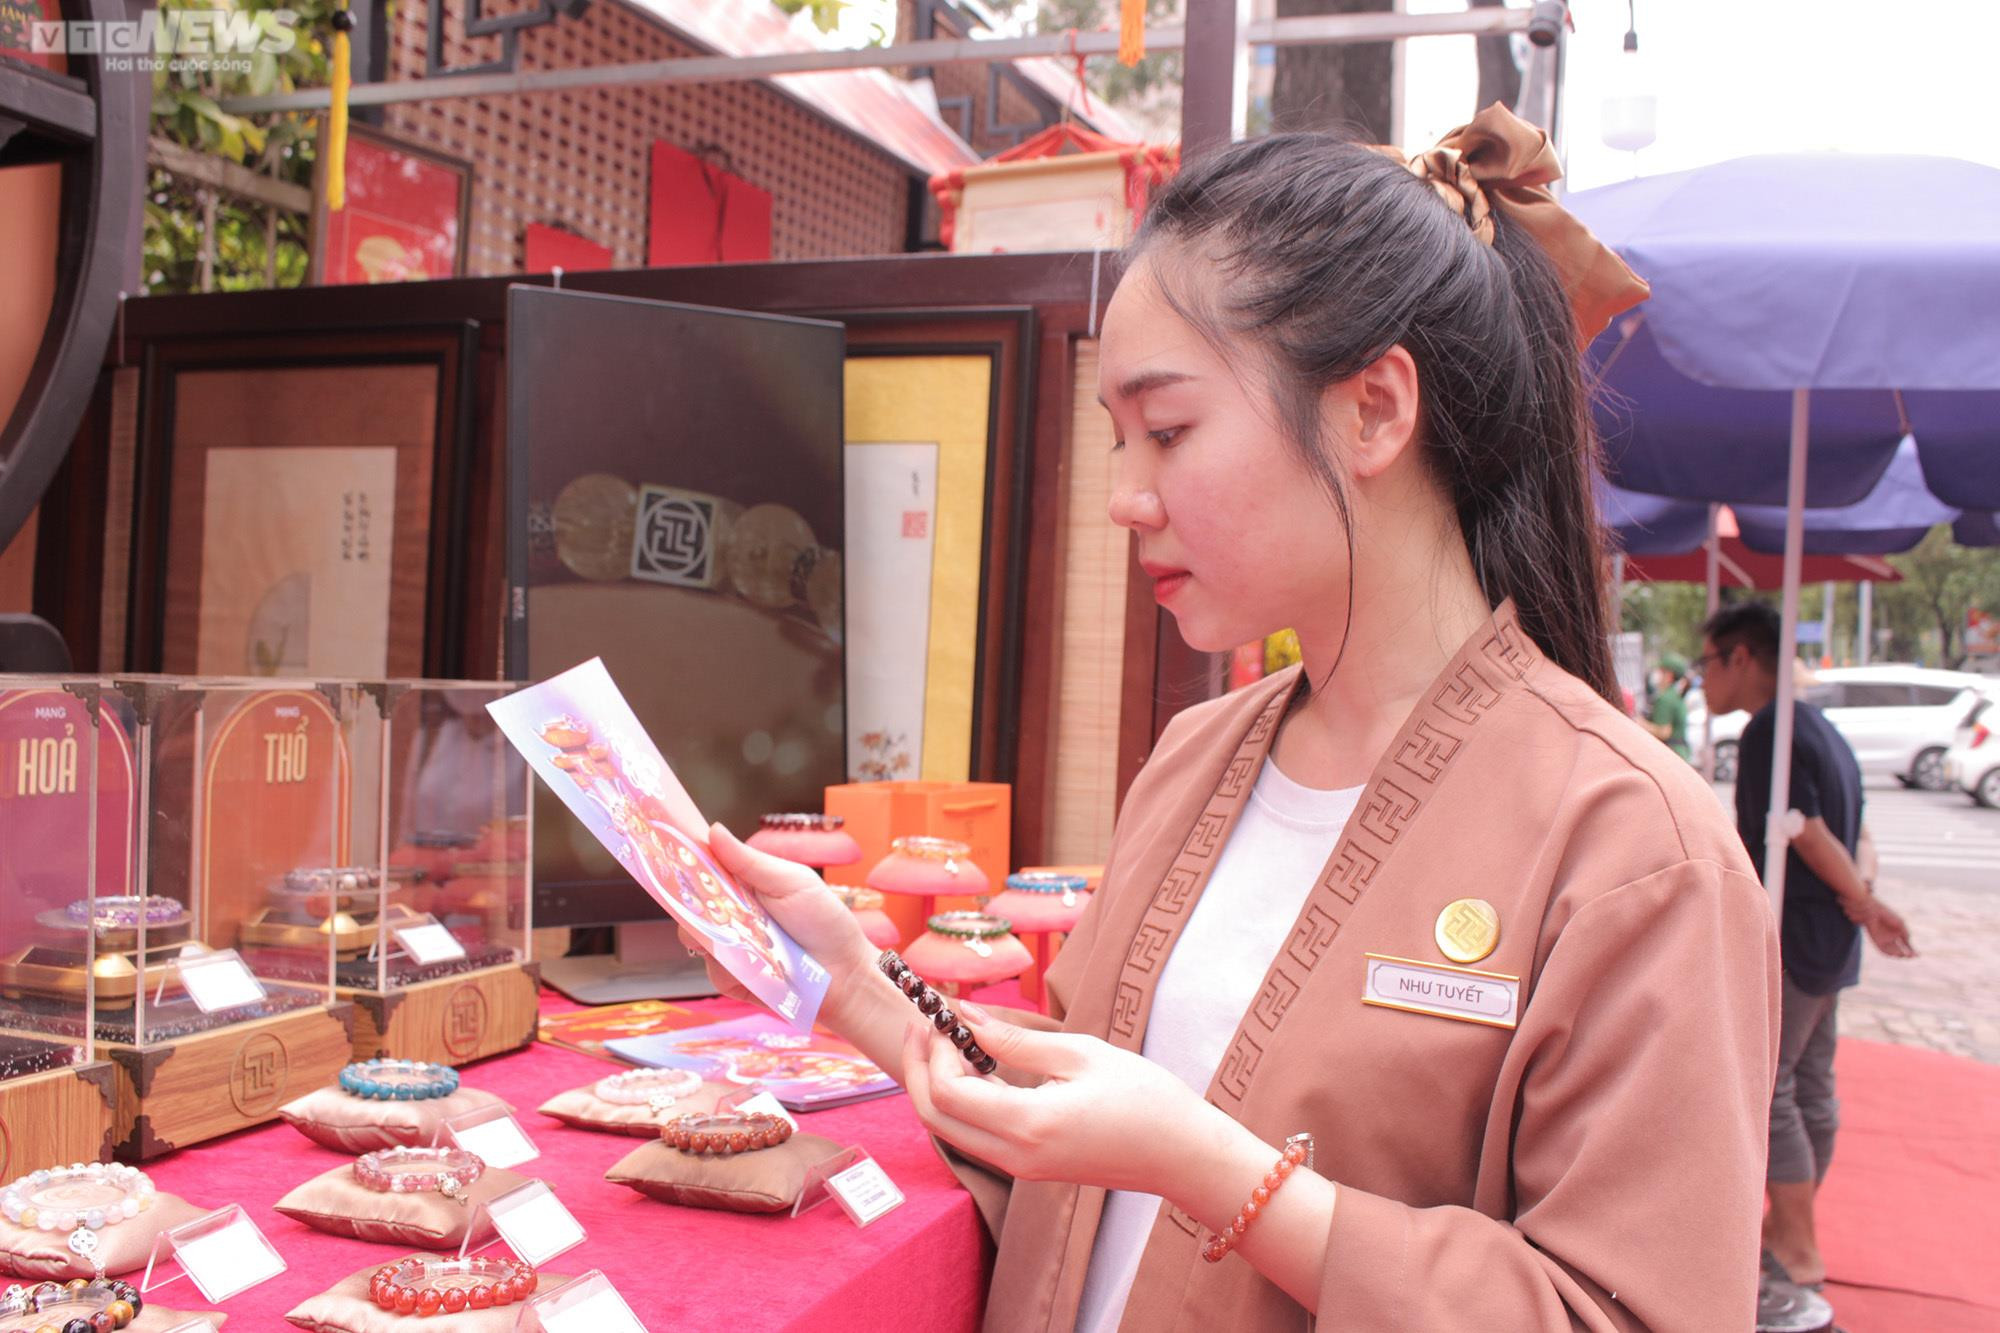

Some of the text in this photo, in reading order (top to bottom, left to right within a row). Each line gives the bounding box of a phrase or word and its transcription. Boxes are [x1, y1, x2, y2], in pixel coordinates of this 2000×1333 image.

[34, 707, 66, 721] MẠNG
[18, 723, 78, 796] HOẢ
[264, 716, 309, 784] THỔ
[1400, 977, 1484, 1003] NHƯ TUYẾT
